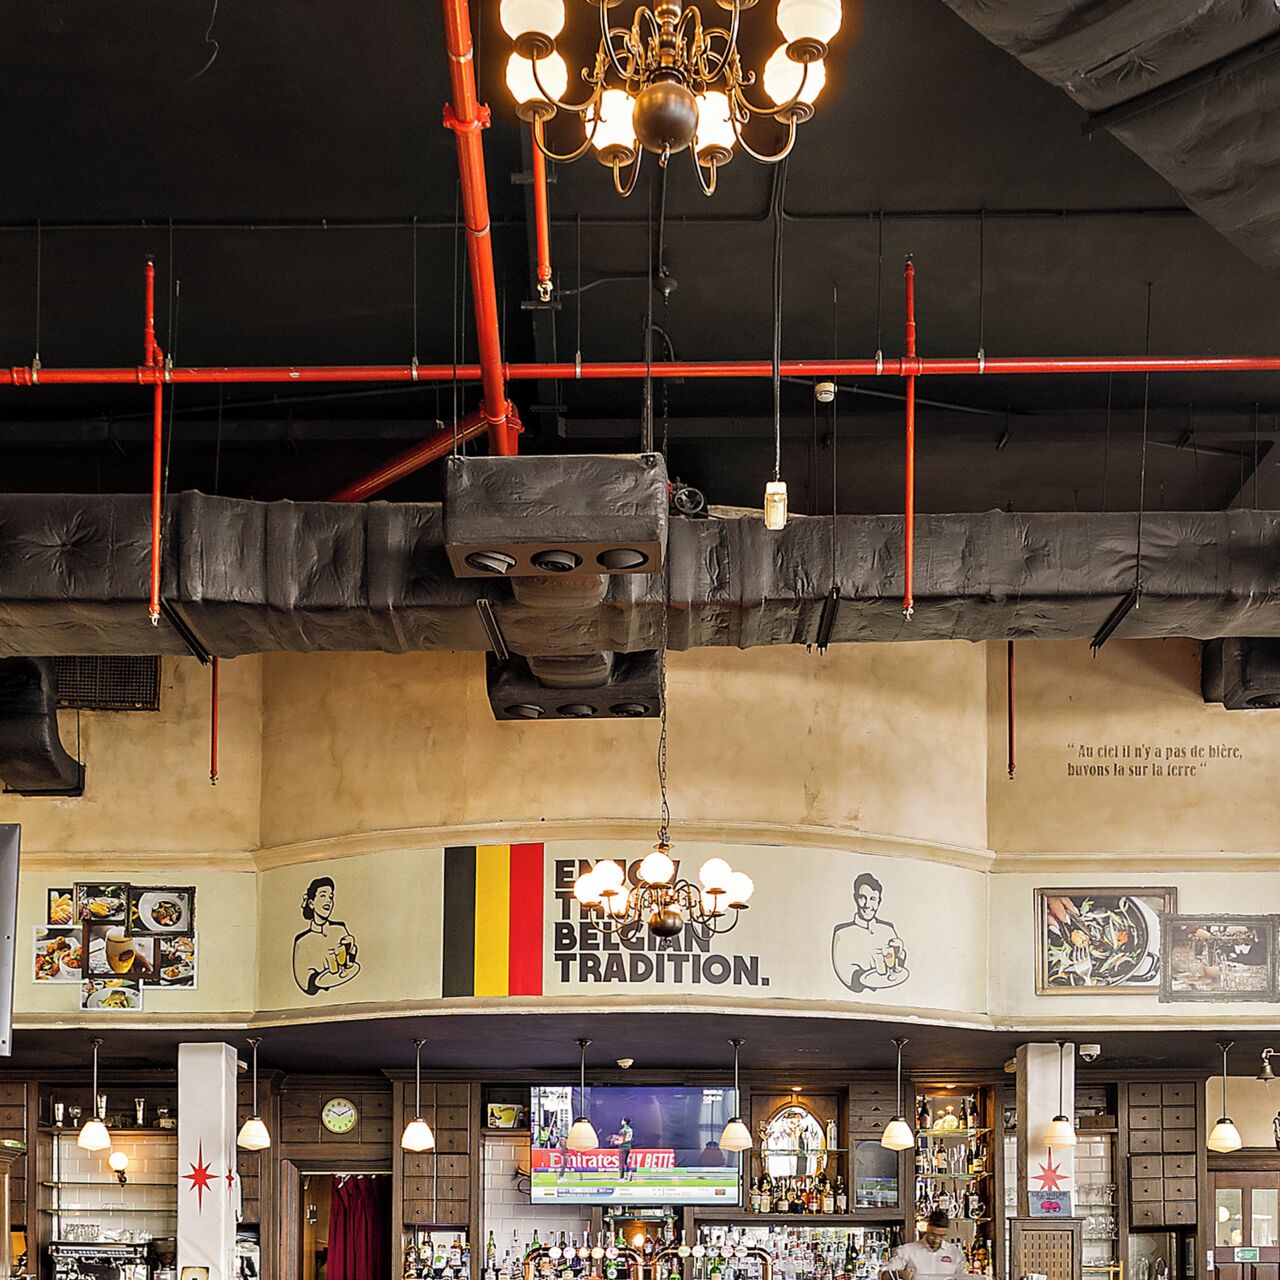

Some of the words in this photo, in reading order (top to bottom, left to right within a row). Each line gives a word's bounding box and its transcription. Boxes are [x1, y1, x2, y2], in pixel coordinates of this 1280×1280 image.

[1078, 744, 1093, 758] Au
[1097, 744, 1118, 758] ciel
[1122, 744, 1131, 758] il
[1134, 743, 1151, 760] n'y
[1154, 746, 1162, 758] a
[1166, 746, 1187, 760] pas
[1190, 744, 1205, 758] de
[1208, 743, 1243, 760] bière,
[1067, 762, 1110, 777] buvons
[1113, 762, 1125, 777] la
[1128, 764, 1148, 777] sur
[1151, 762, 1163, 777] la
[1166, 762, 1197, 777] terre
[555, 921, 711, 953] BELGIAN
[555, 953, 770, 987] TRADITION.
[549, 1151, 619, 1168] Emirates
